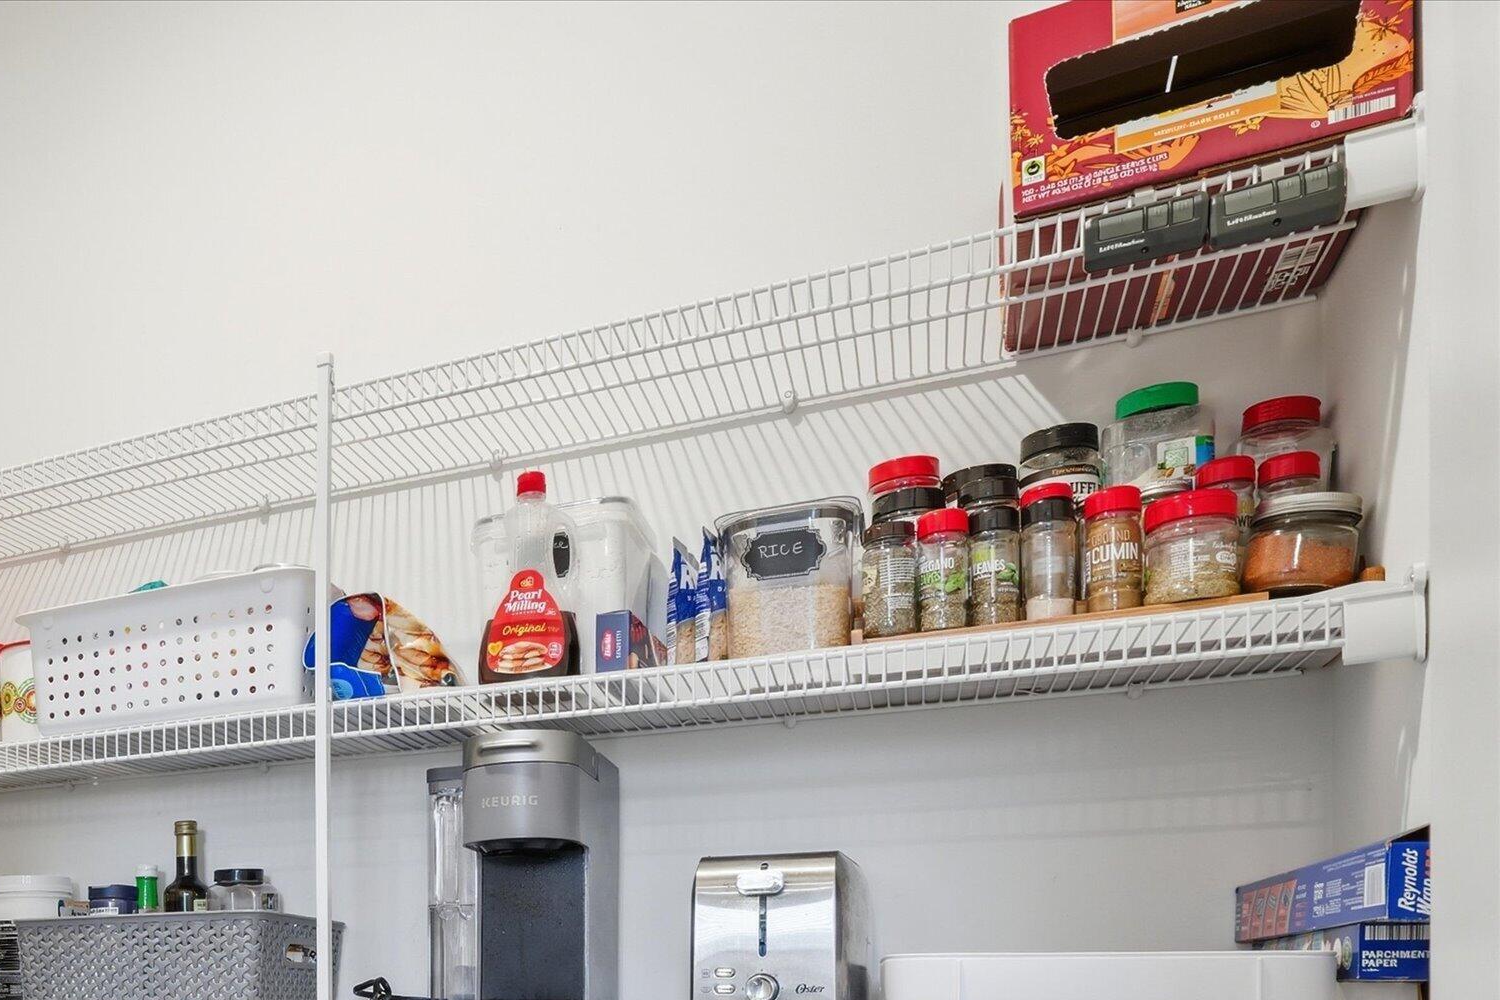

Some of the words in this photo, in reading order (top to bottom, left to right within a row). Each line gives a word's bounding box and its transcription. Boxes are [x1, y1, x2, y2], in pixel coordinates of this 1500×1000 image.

[758, 541, 803, 559] RICE
[1092, 542, 1139, 564] CUMIN
[973, 558, 1006, 576] LEAVES
[510, 589, 543, 602] Pearl
[504, 600, 547, 613] Milling
[502, 622, 547, 637] Original
[482, 795, 538, 809] KEURIG
[1397, 848, 1419, 913] Reynolds
[1361, 959, 1398, 968] PAPER
[795, 983, 825, 994] Oster
